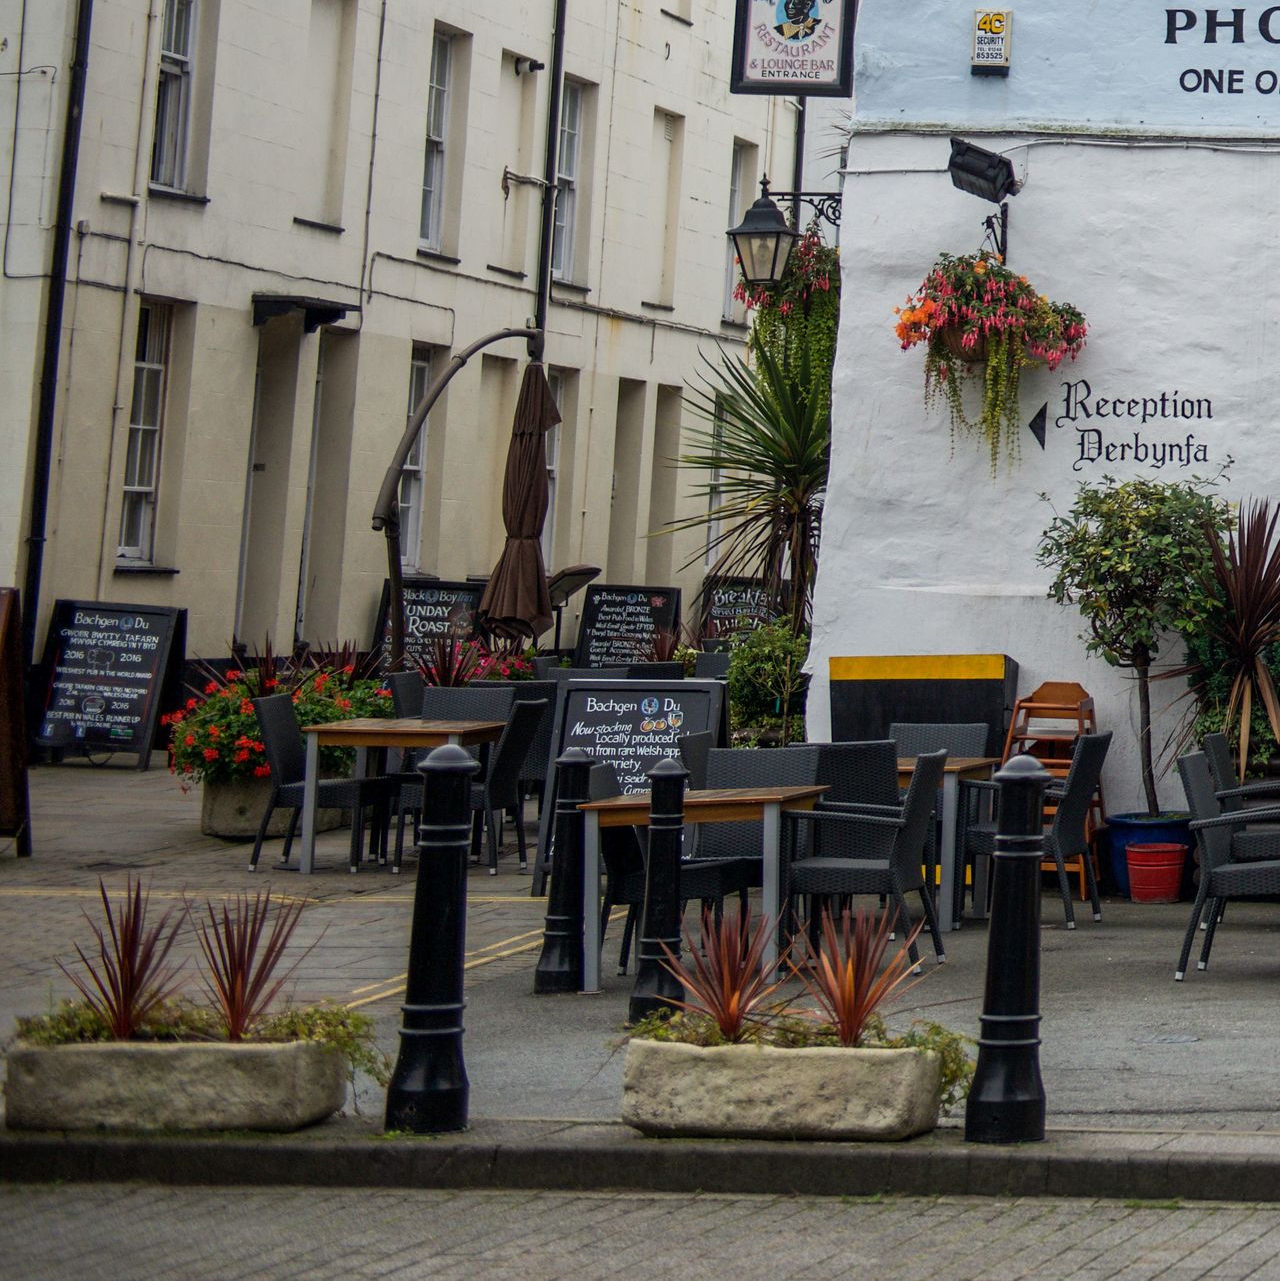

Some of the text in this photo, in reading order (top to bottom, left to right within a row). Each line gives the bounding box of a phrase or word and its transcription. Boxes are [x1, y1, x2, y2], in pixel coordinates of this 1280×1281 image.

[754, 23, 836, 58] RESTAURANT
[976, 36, 1005, 45] SECURITY
[750, 59, 835, 71] & LOUNGE BAR
[761, 70, 821, 79] ENTRANCE
[1180, 69, 1245, 94] ONE
[1056, 379, 1214, 429] Reception
[1073, 426, 1209, 472] Derbynfa
[440, 590, 458, 604] Boy
[601, 592, 647, 602] Bachgen Du
[403, 601, 452, 617] UNDAY
[74, 612, 149, 629] Bachgen Du
[408, 616, 451, 637] ROAST
[91, 631, 120, 639] BWYTY
[125, 634, 159, 643] TAFARN
[64, 650, 85, 659] 2016
[120, 653, 142, 662] 2016
[587, 697, 680, 716] Bachgen Du
[47, 711, 63, 719] BEST
[82, 713, 104, 721] WALES
[105, 715, 131, 723] RUNNER
[571, 721, 632, 736] Now stocking
[595, 733, 630, 746] Locally
[632, 733, 673, 745] produced
[596, 744, 617, 756] from
[618, 746, 635, 756] rare
[636, 746, 662, 756] Welsh
